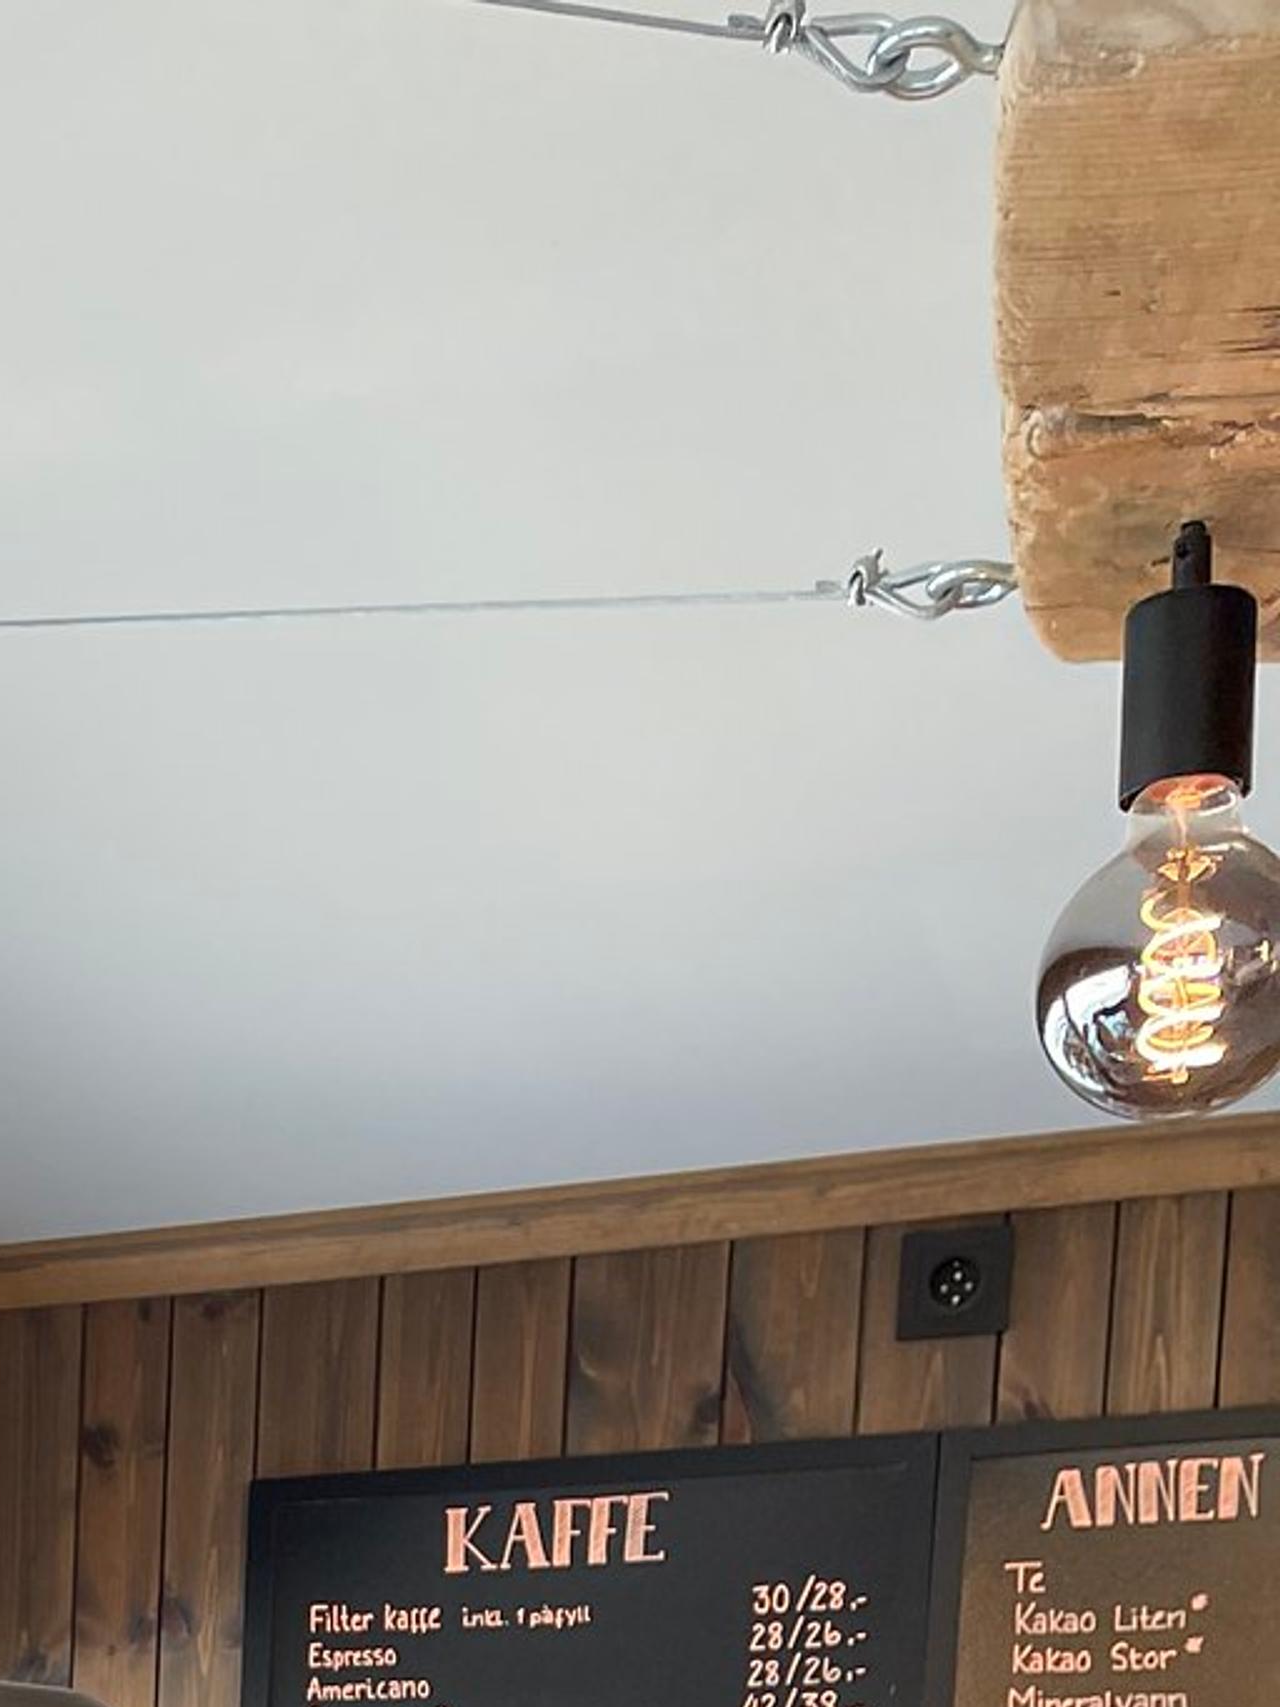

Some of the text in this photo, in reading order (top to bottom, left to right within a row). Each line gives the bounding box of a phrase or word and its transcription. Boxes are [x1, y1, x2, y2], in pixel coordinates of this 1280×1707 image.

[1041, 1453, 1265, 1531] ANNEN
[444, 1491, 670, 1574] KAFFE
[1004, 1560, 1046, 1594] Te
[309, 1604, 375, 1633] Filter
[383, 1603, 442, 1634] kaffe
[1014, 1602, 1097, 1636] Kakao
[307, 1641, 398, 1672] Espresso
[1011, 1643, 1093, 1676] Kakao
[306, 1676, 432, 1701] Americano
